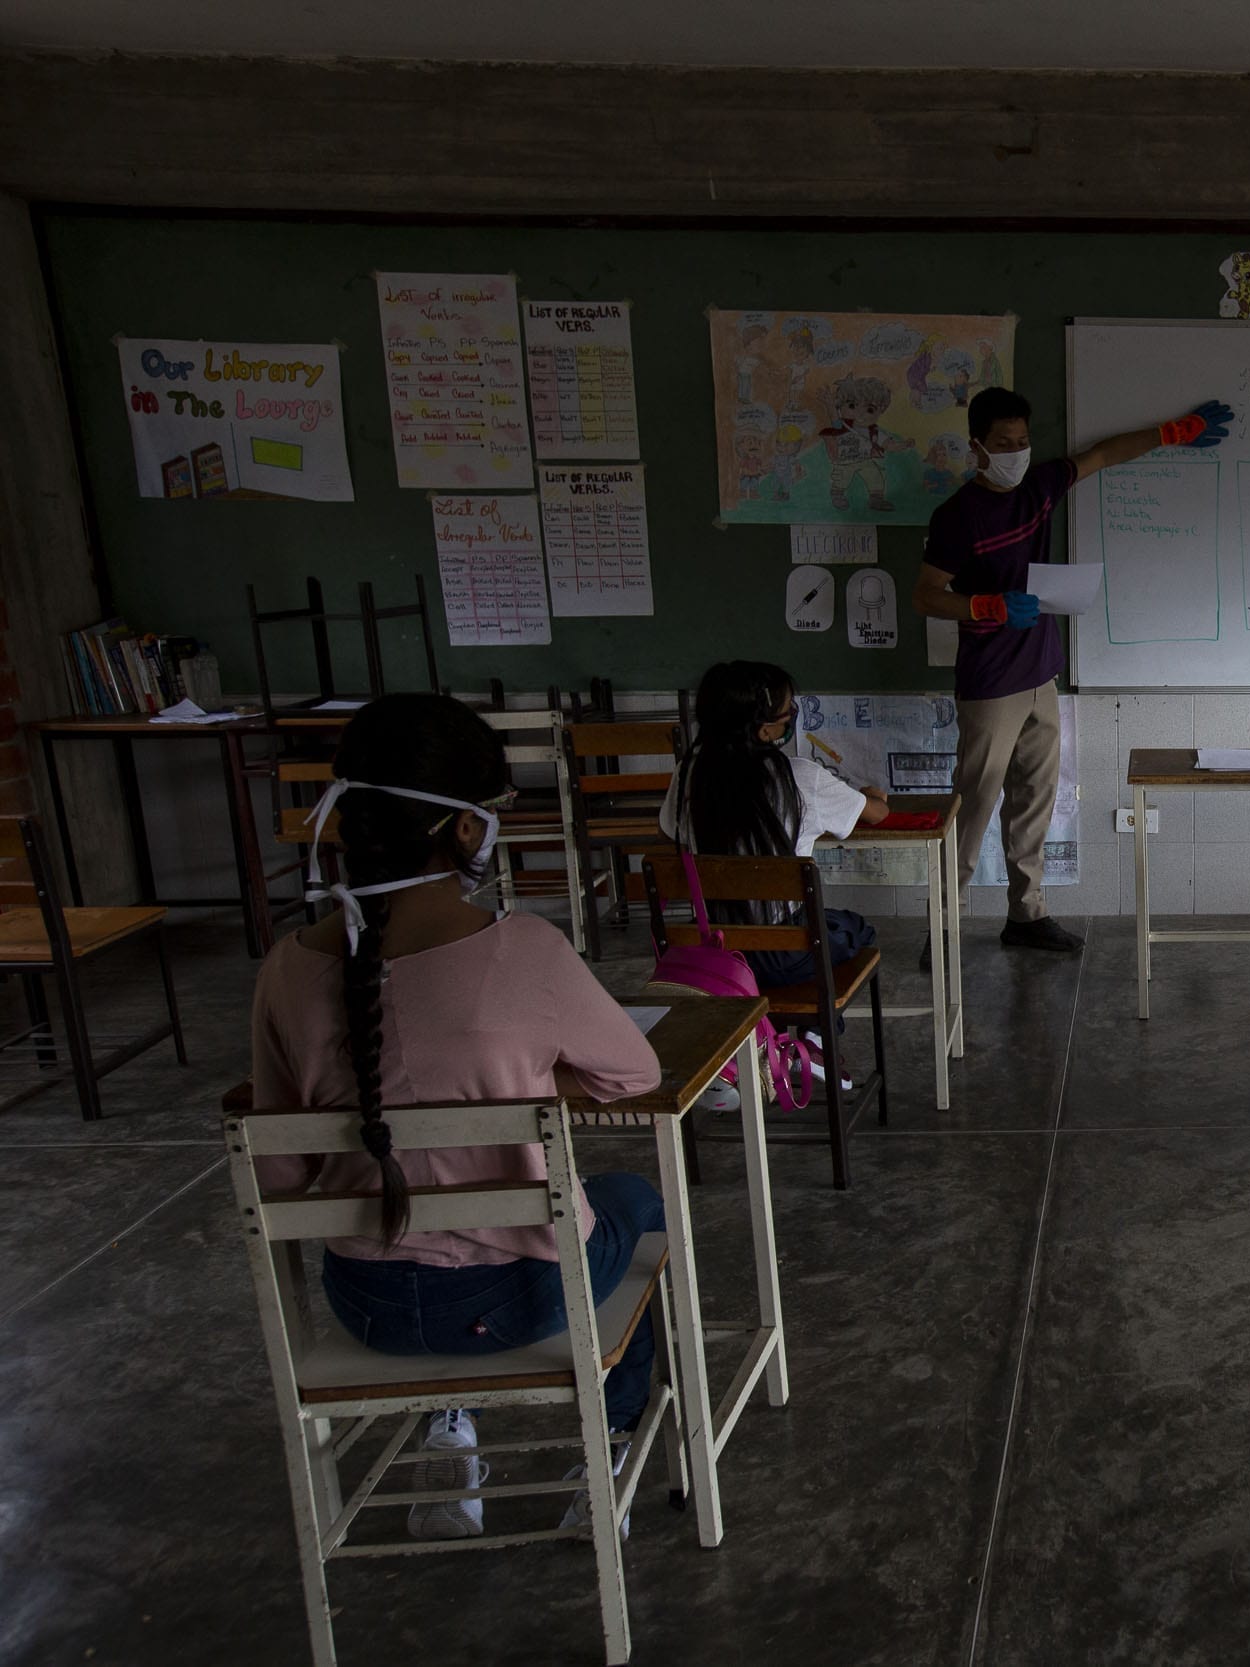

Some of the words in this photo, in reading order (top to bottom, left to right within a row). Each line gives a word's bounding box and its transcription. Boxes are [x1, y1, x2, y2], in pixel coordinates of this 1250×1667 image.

[555, 307, 568, 318] OF
[141, 348, 195, 381] Our
[204, 348, 324, 388] Library
[131, 385, 160, 415] in
[167, 390, 226, 419] The
[571, 472, 583, 484] OF
[434, 500, 474, 518] List
[480, 499, 502, 525] of
[797, 535, 873, 554] ELECTRONIC
[795, 619, 820, 629] Diode
[800, 695, 848, 732] Basic
